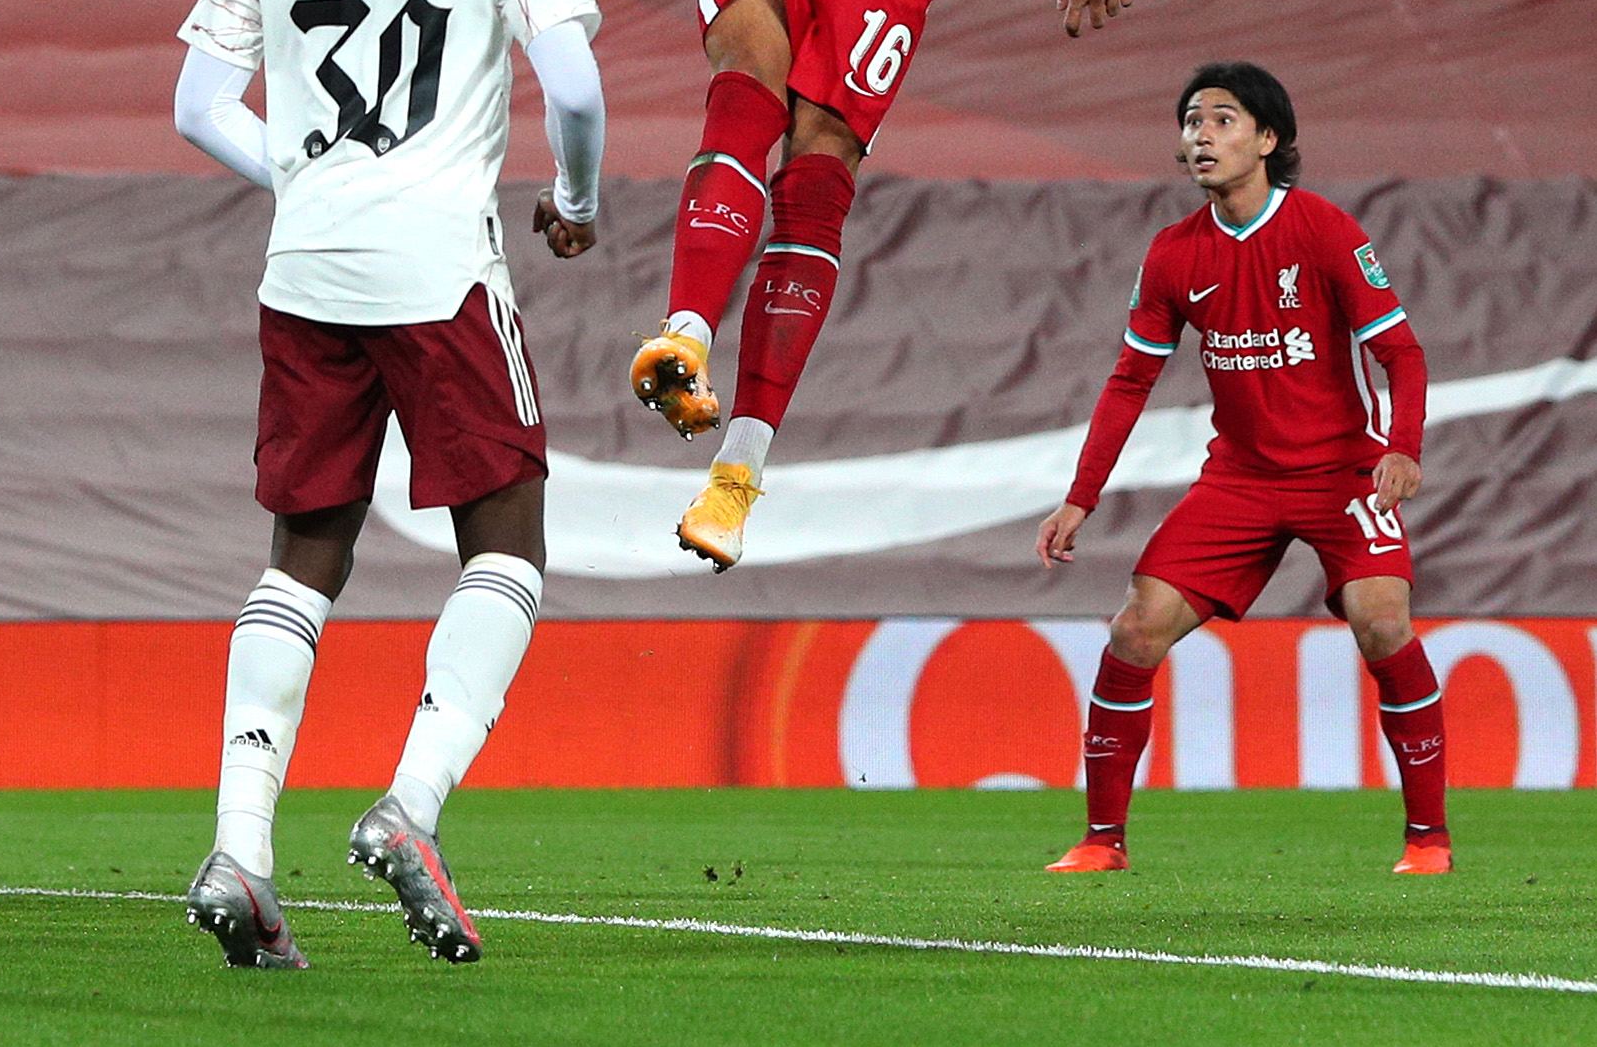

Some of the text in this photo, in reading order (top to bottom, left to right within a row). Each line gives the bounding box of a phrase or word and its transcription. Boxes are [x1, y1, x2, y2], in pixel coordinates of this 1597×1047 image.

[849, 9, 912, 95] 16
[1206, 328, 1280, 349] Standard
[1203, 349, 1284, 370] Chartered
[1344, 493, 1403, 540] 18
